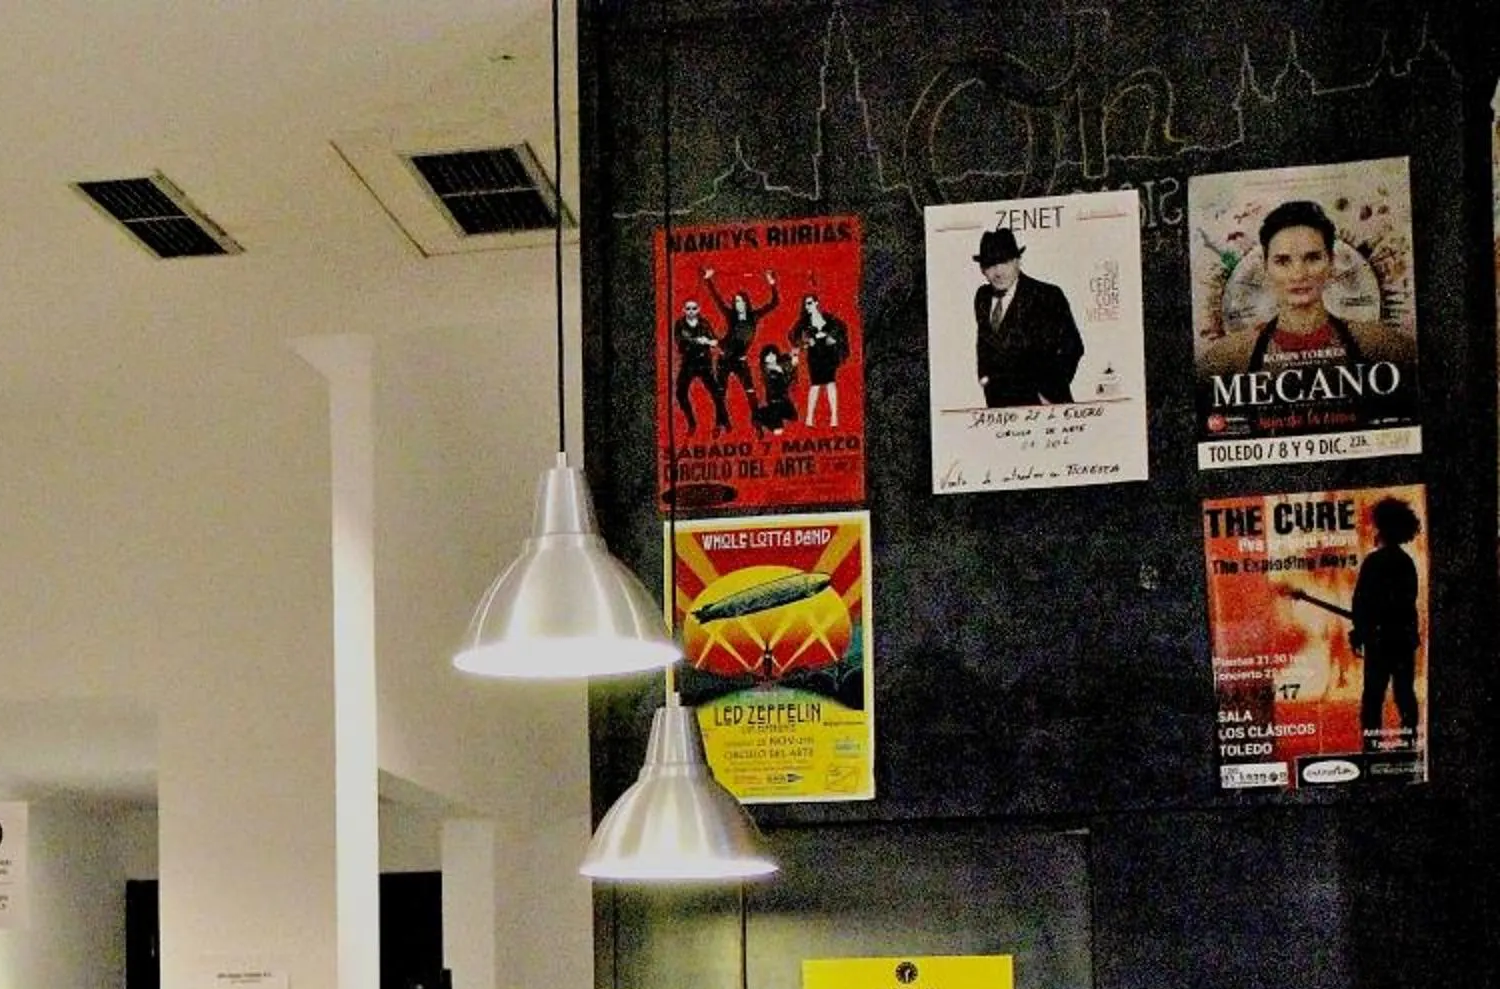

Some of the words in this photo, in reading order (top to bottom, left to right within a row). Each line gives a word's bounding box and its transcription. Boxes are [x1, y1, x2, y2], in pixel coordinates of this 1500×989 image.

[995, 205, 1064, 231] ZENET
[1211, 361, 1400, 407] MECANO
[782, 436, 861, 453] MARZO
[1208, 442, 1263, 463] TOLEDO
[1278, 441, 1289, 457] 8
[1291, 441, 1301, 457] Y
[1305, 439, 1315, 455] 9
[1319, 437, 1347, 455] DIC.
[663, 460, 732, 482] CRCULO
[739, 460, 765, 479] DEL
[774, 456, 816, 477] ARTE
[1205, 506, 1263, 537] THE
[1273, 500, 1356, 535] CURE
[702, 532, 748, 551] WHOLE
[750, 530, 792, 548] LOTTA
[795, 528, 831, 546] BAND
[1279, 684, 1301, 700] 17
[747, 703, 821, 725] ZEPPELIN
[1217, 710, 1253, 723] SALA
[1218, 727, 1245, 740] LOS
[1247, 722, 1317, 738] CLÁSICOS
[1219, 743, 1273, 757] TOLEDO
